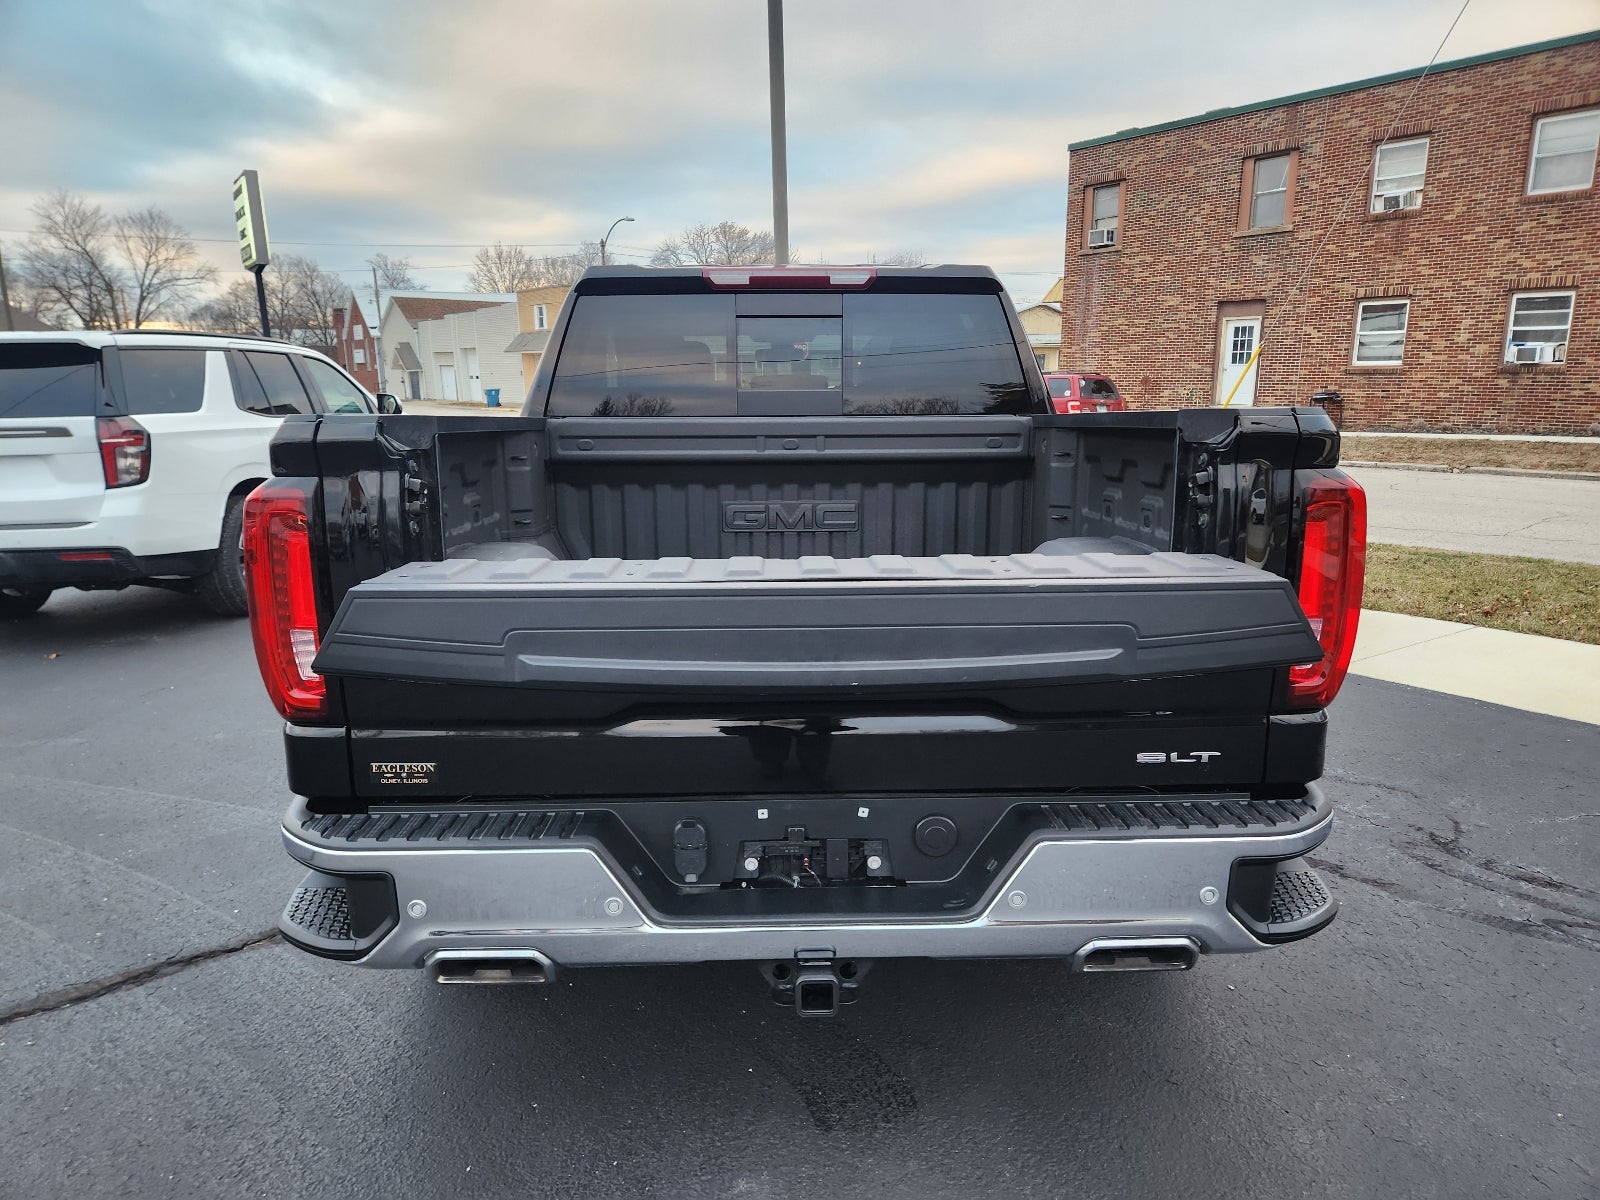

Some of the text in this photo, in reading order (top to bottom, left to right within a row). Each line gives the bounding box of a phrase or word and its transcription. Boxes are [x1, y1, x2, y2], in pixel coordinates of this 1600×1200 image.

[724, 502, 857, 530] GMC
[1136, 751, 1222, 764] SLT
[371, 762, 436, 773] EAGLESON
